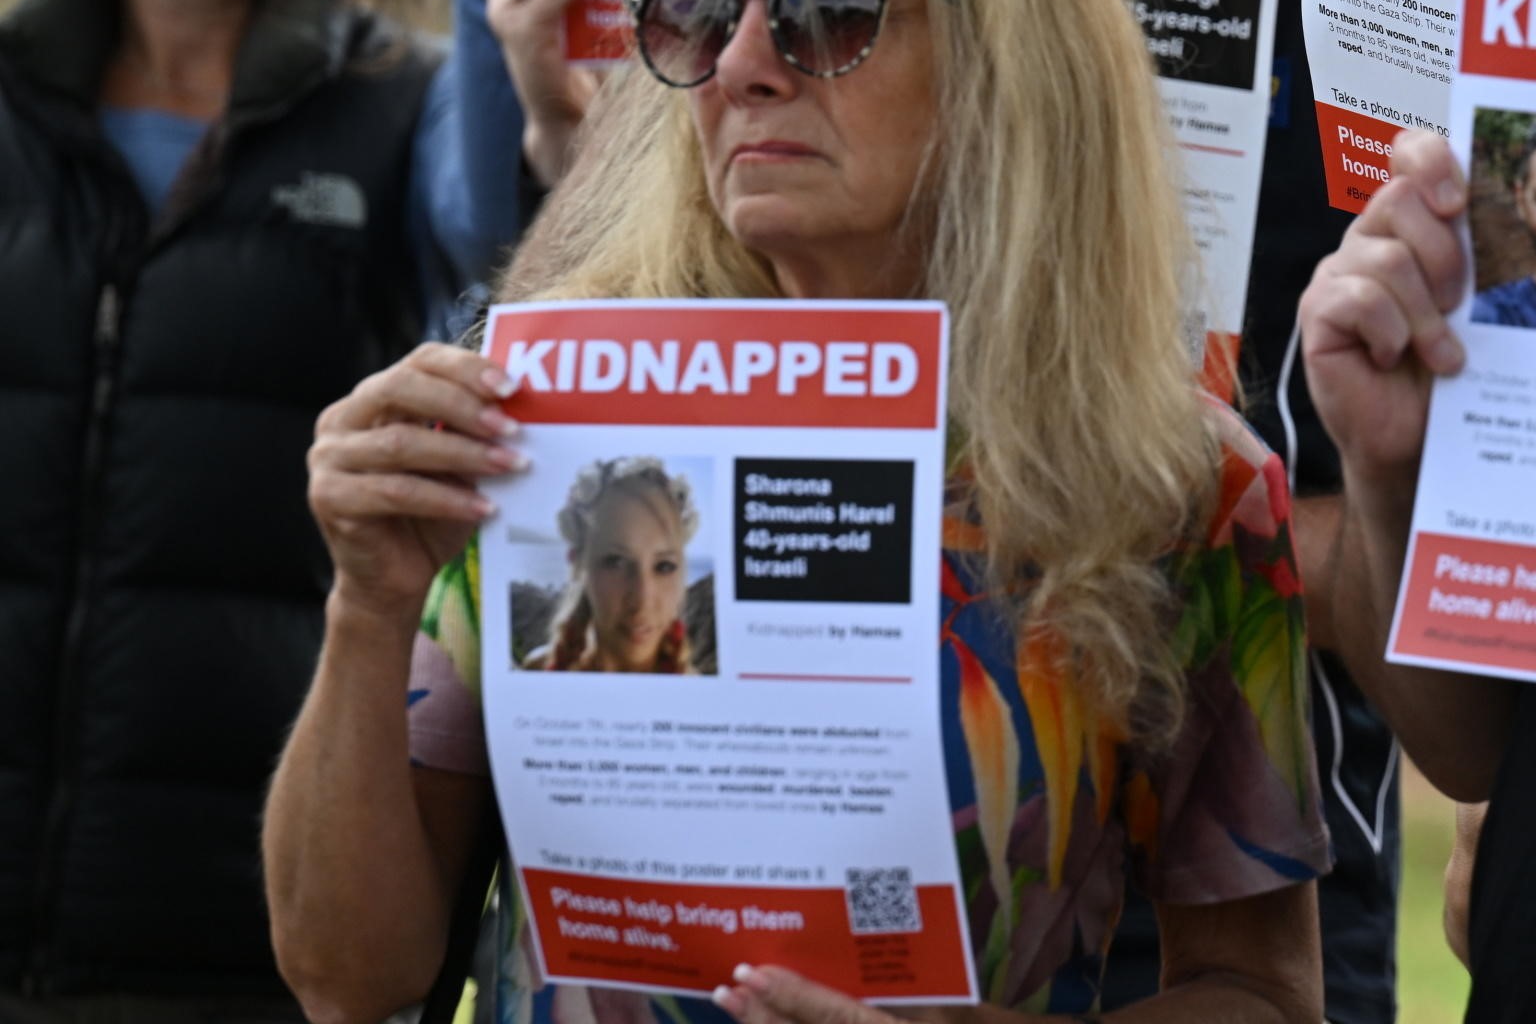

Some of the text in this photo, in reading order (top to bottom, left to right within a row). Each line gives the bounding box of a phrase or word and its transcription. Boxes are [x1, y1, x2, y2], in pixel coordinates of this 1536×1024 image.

[1319, 4, 1455, 57] More than 3,000 women, men, an
[1363, 0, 1376, 12] the
[1377, 4, 1400, 20] Gaza
[1425, 18, 1446, 34] Their
[1328, 21, 1335, 32] 3
[1336, 26, 1366, 42] months
[1367, 35, 1376, 45] to
[1377, 38, 1388, 50] 85
[1389, 44, 1412, 58] years
[1430, 57, 1450, 71] were
[1368, 48, 1383, 61] and
[1384, 54, 1414, 74] brutally
[1331, 87, 1357, 107] Take
[1360, 99, 1368, 111] a
[1370, 102, 1400, 121] photo
[1403, 113, 1413, 125] of
[1415, 116, 1435, 133] this
[1337, 125, 1393, 157] Please
[1342, 153, 1390, 182] home
[504, 337, 919, 397] KIDNAPPED
[744, 473, 832, 496] Sharona
[744, 500, 835, 523] Shmunis
[744, 529, 871, 554] 40-years-old
[744, 556, 807, 577] Israeli
[1434, 553, 1510, 586] Please
[1428, 589, 1492, 618] home
[550, 885, 804, 934] Please help bring them
[558, 916, 619, 943] home
